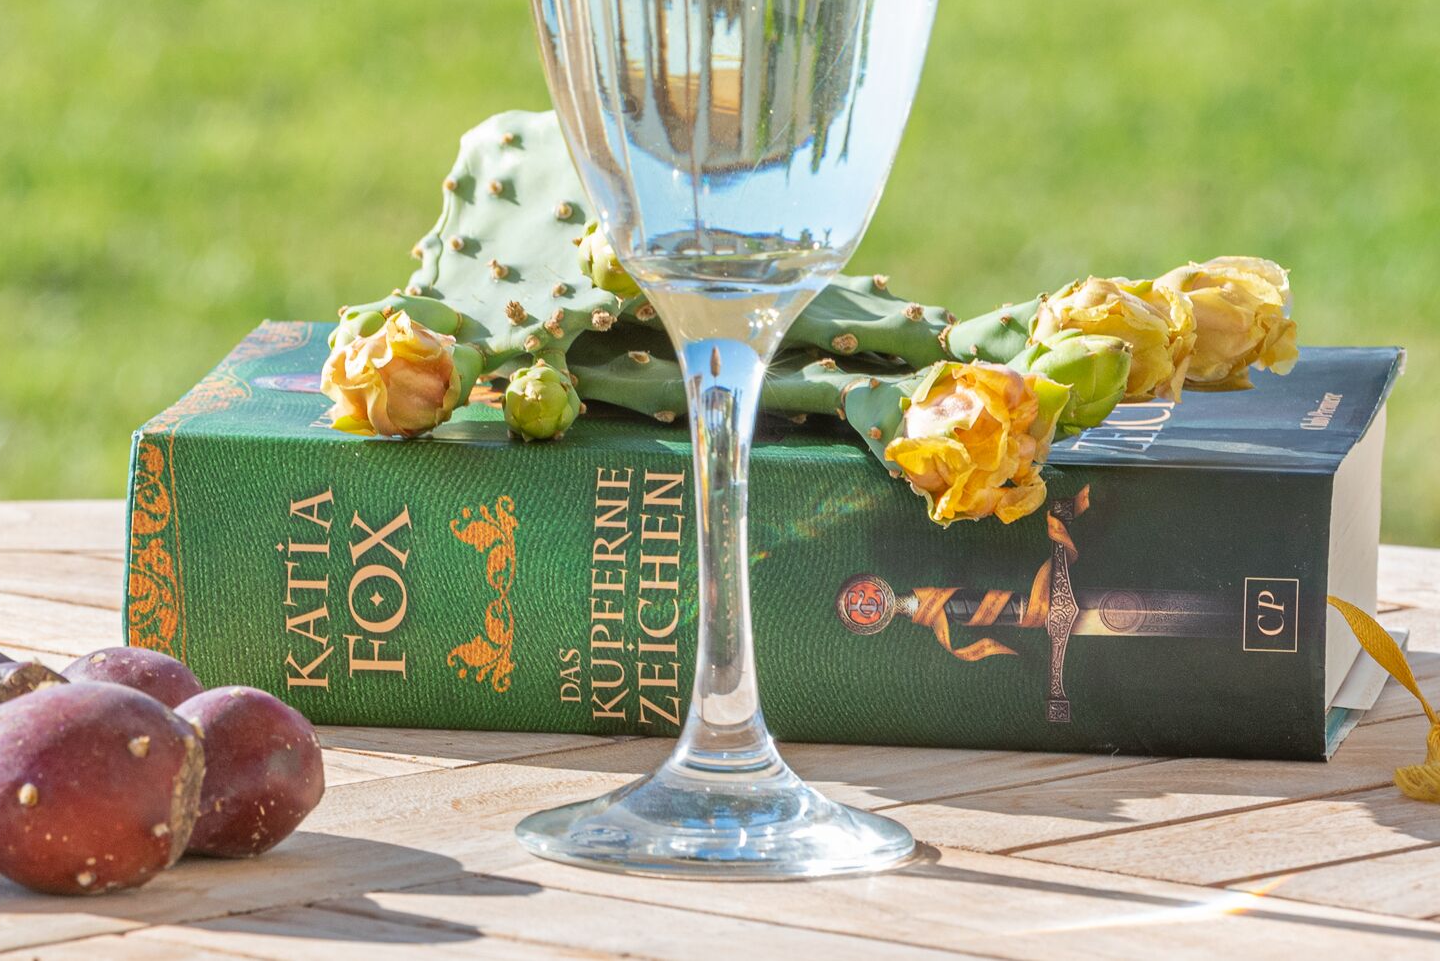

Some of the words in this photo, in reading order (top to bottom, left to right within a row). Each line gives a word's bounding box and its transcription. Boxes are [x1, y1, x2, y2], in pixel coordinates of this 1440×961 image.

[276, 485, 335, 693] KATIA
[342, 504, 413, 681] FOX
[559, 647, 582, 704] DAS
[589, 466, 635, 722] KUPFERNE
[627, 468, 686, 727] ZEICHEN
[1256, 589, 1287, 638] CP
